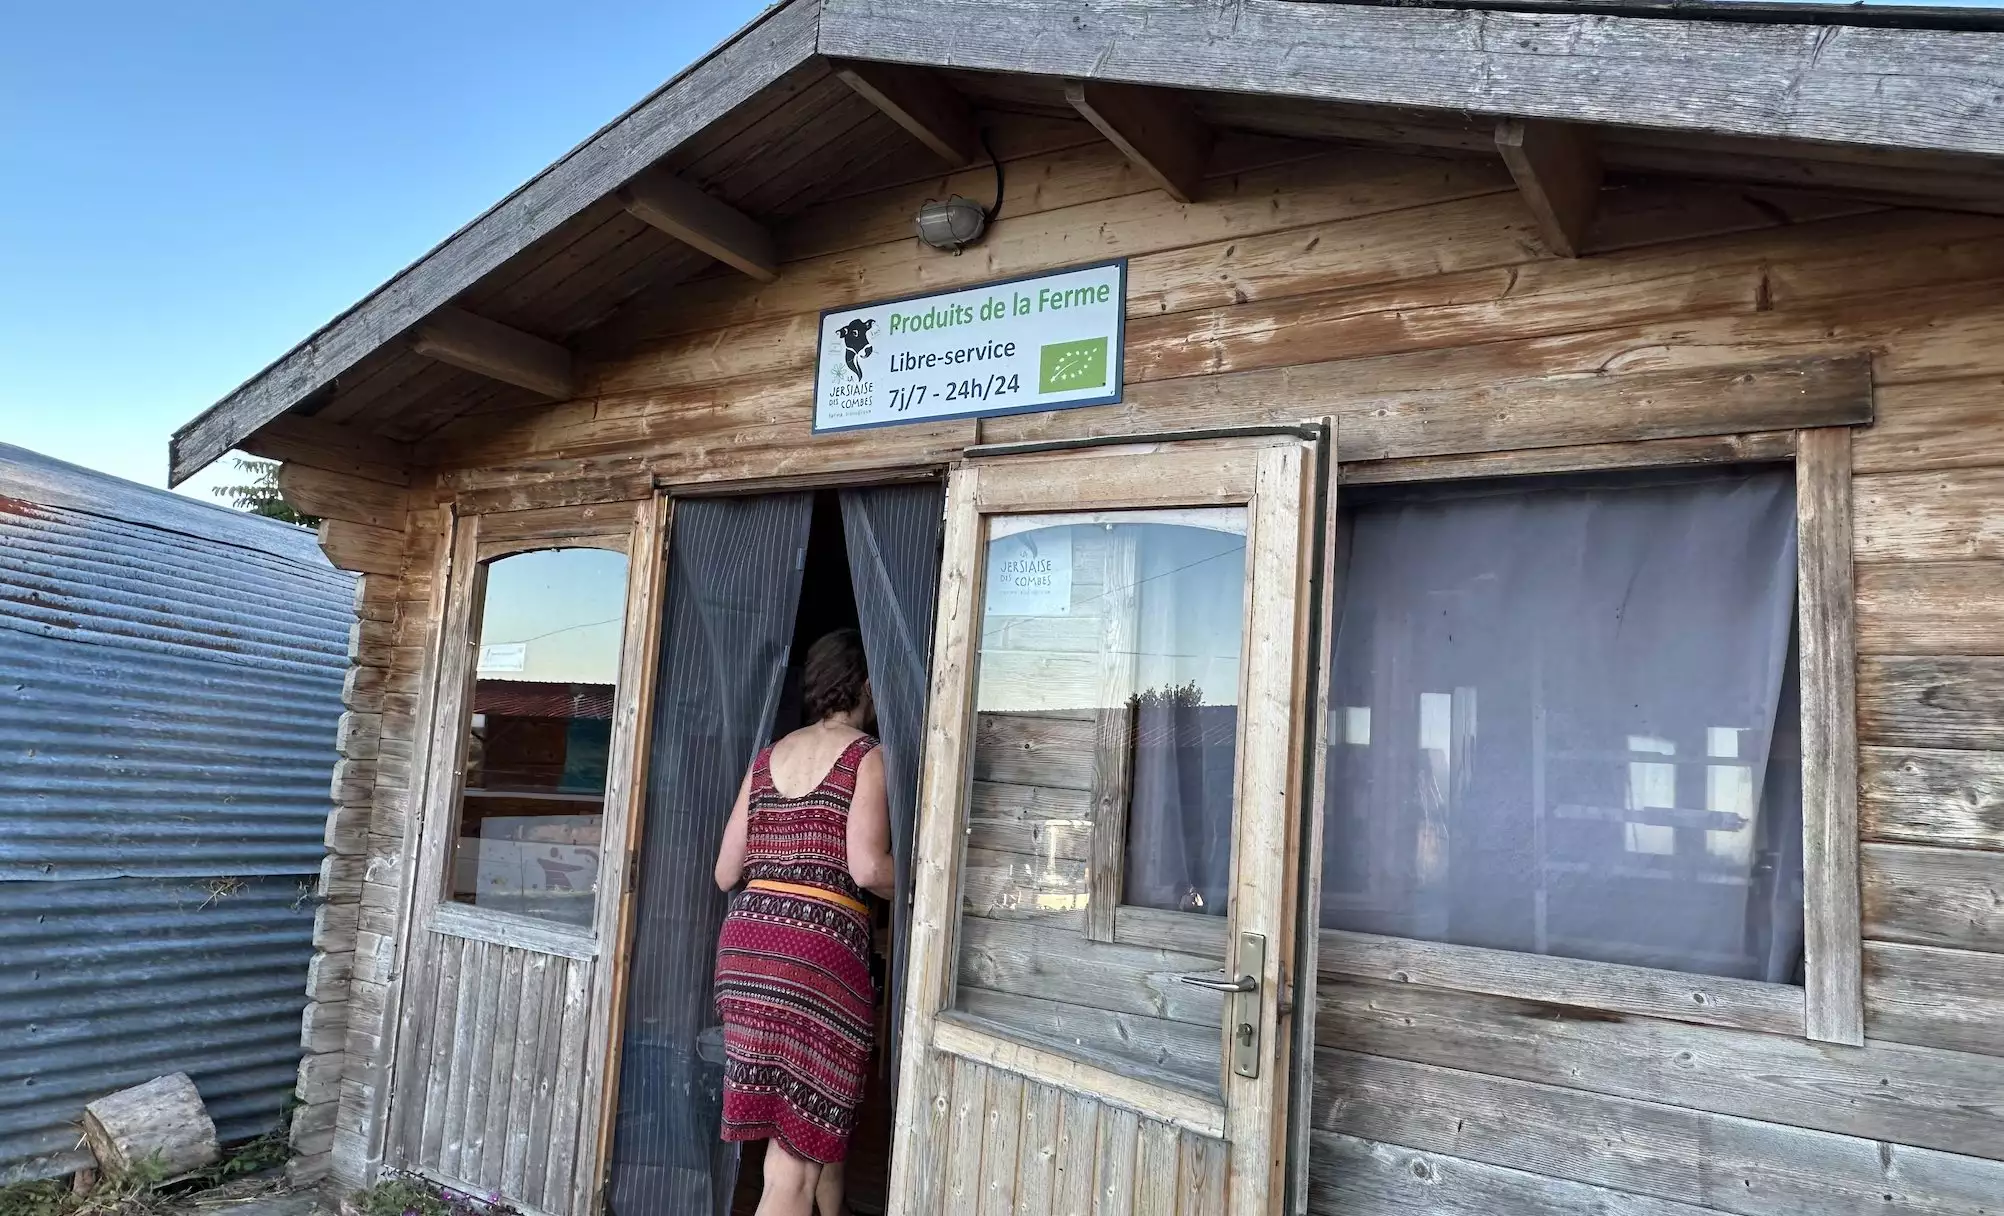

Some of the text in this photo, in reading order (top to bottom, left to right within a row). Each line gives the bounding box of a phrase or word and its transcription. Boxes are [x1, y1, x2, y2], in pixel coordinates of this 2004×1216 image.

[889, 283, 1110, 335] Produits de la Ferme
[890, 340, 1016, 373] Libre-service
[829, 381, 873, 397] JERSIAISE
[889, 384, 927, 412] 7j/7
[945, 374, 1020, 401] 24h/24
[841, 395, 873, 409] COMBES
[1000, 558, 1052, 573] JERSIAISE
[1014, 574, 1052, 587] COMBES
